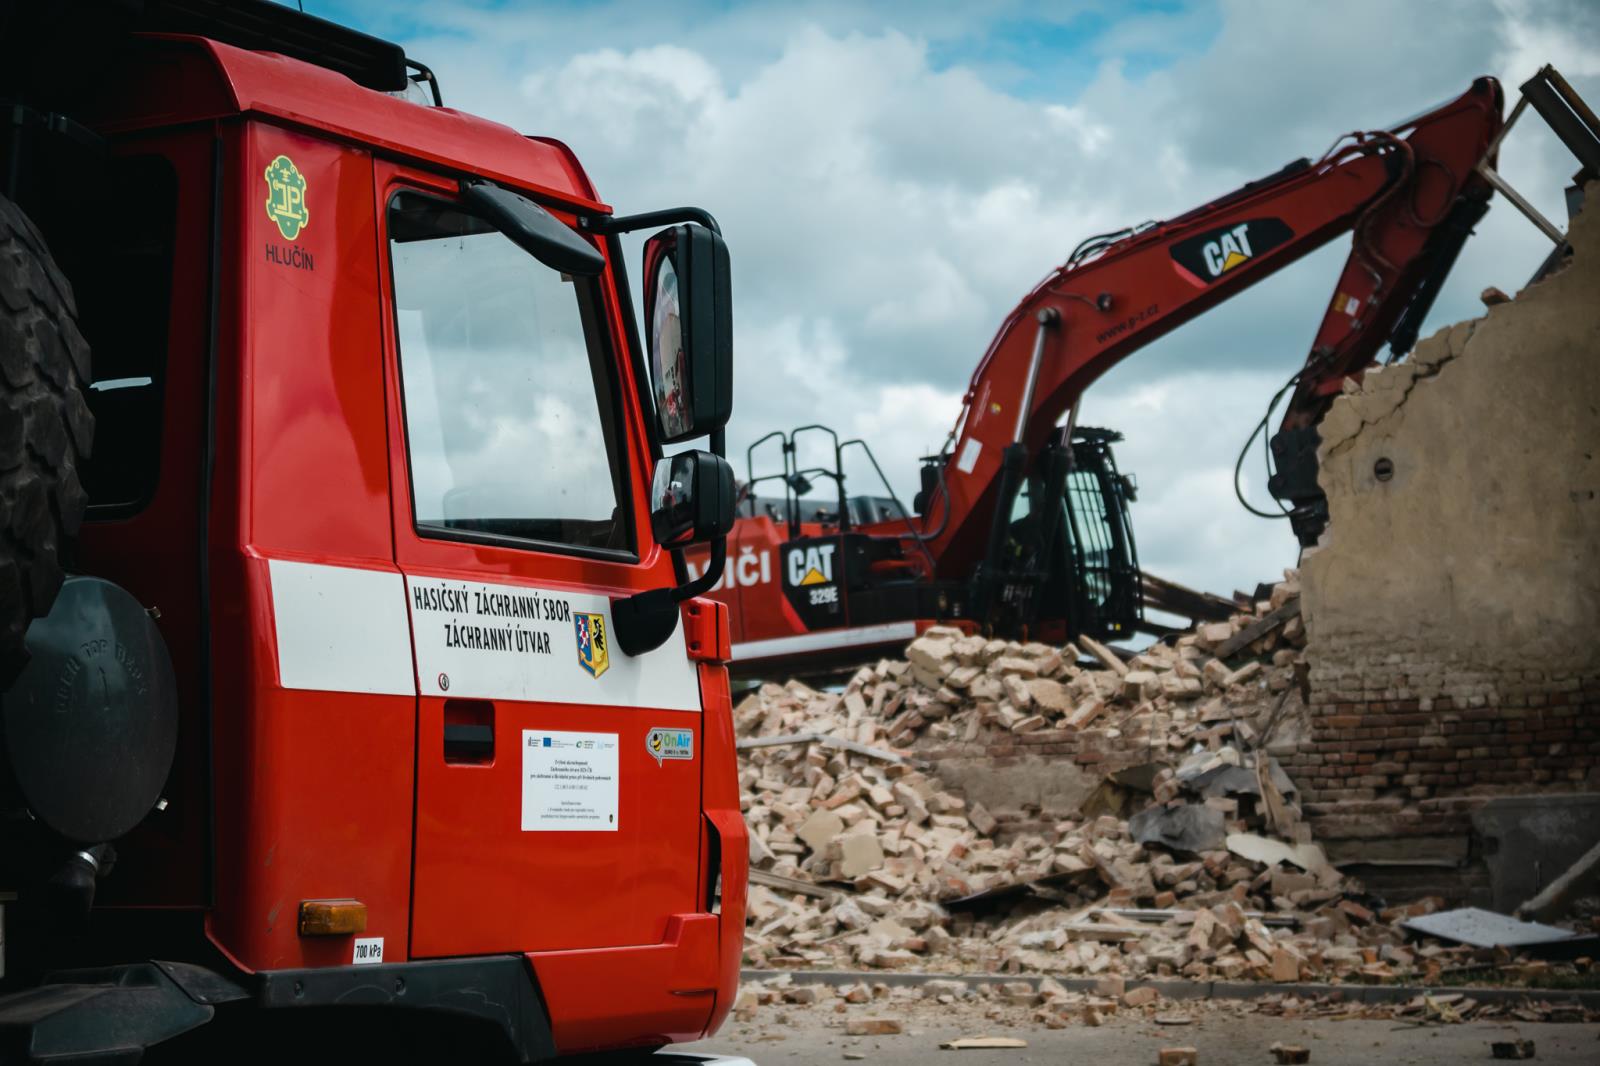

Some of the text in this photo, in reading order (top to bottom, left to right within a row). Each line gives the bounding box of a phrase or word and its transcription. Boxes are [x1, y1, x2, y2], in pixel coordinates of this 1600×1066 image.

[265, 243, 314, 271] HLUČÍN
[1202, 223, 1252, 277] CAT
[788, 544, 836, 587] CAT
[413, 583, 571, 622] HASIČSKÝ ZÁCHRANNÝ SBOR
[444, 619, 552, 654] ZÁCHRANNÝ ÚTVAR
[664, 733, 691, 748] OnAir
[356, 944, 382, 959] 700 kPa
